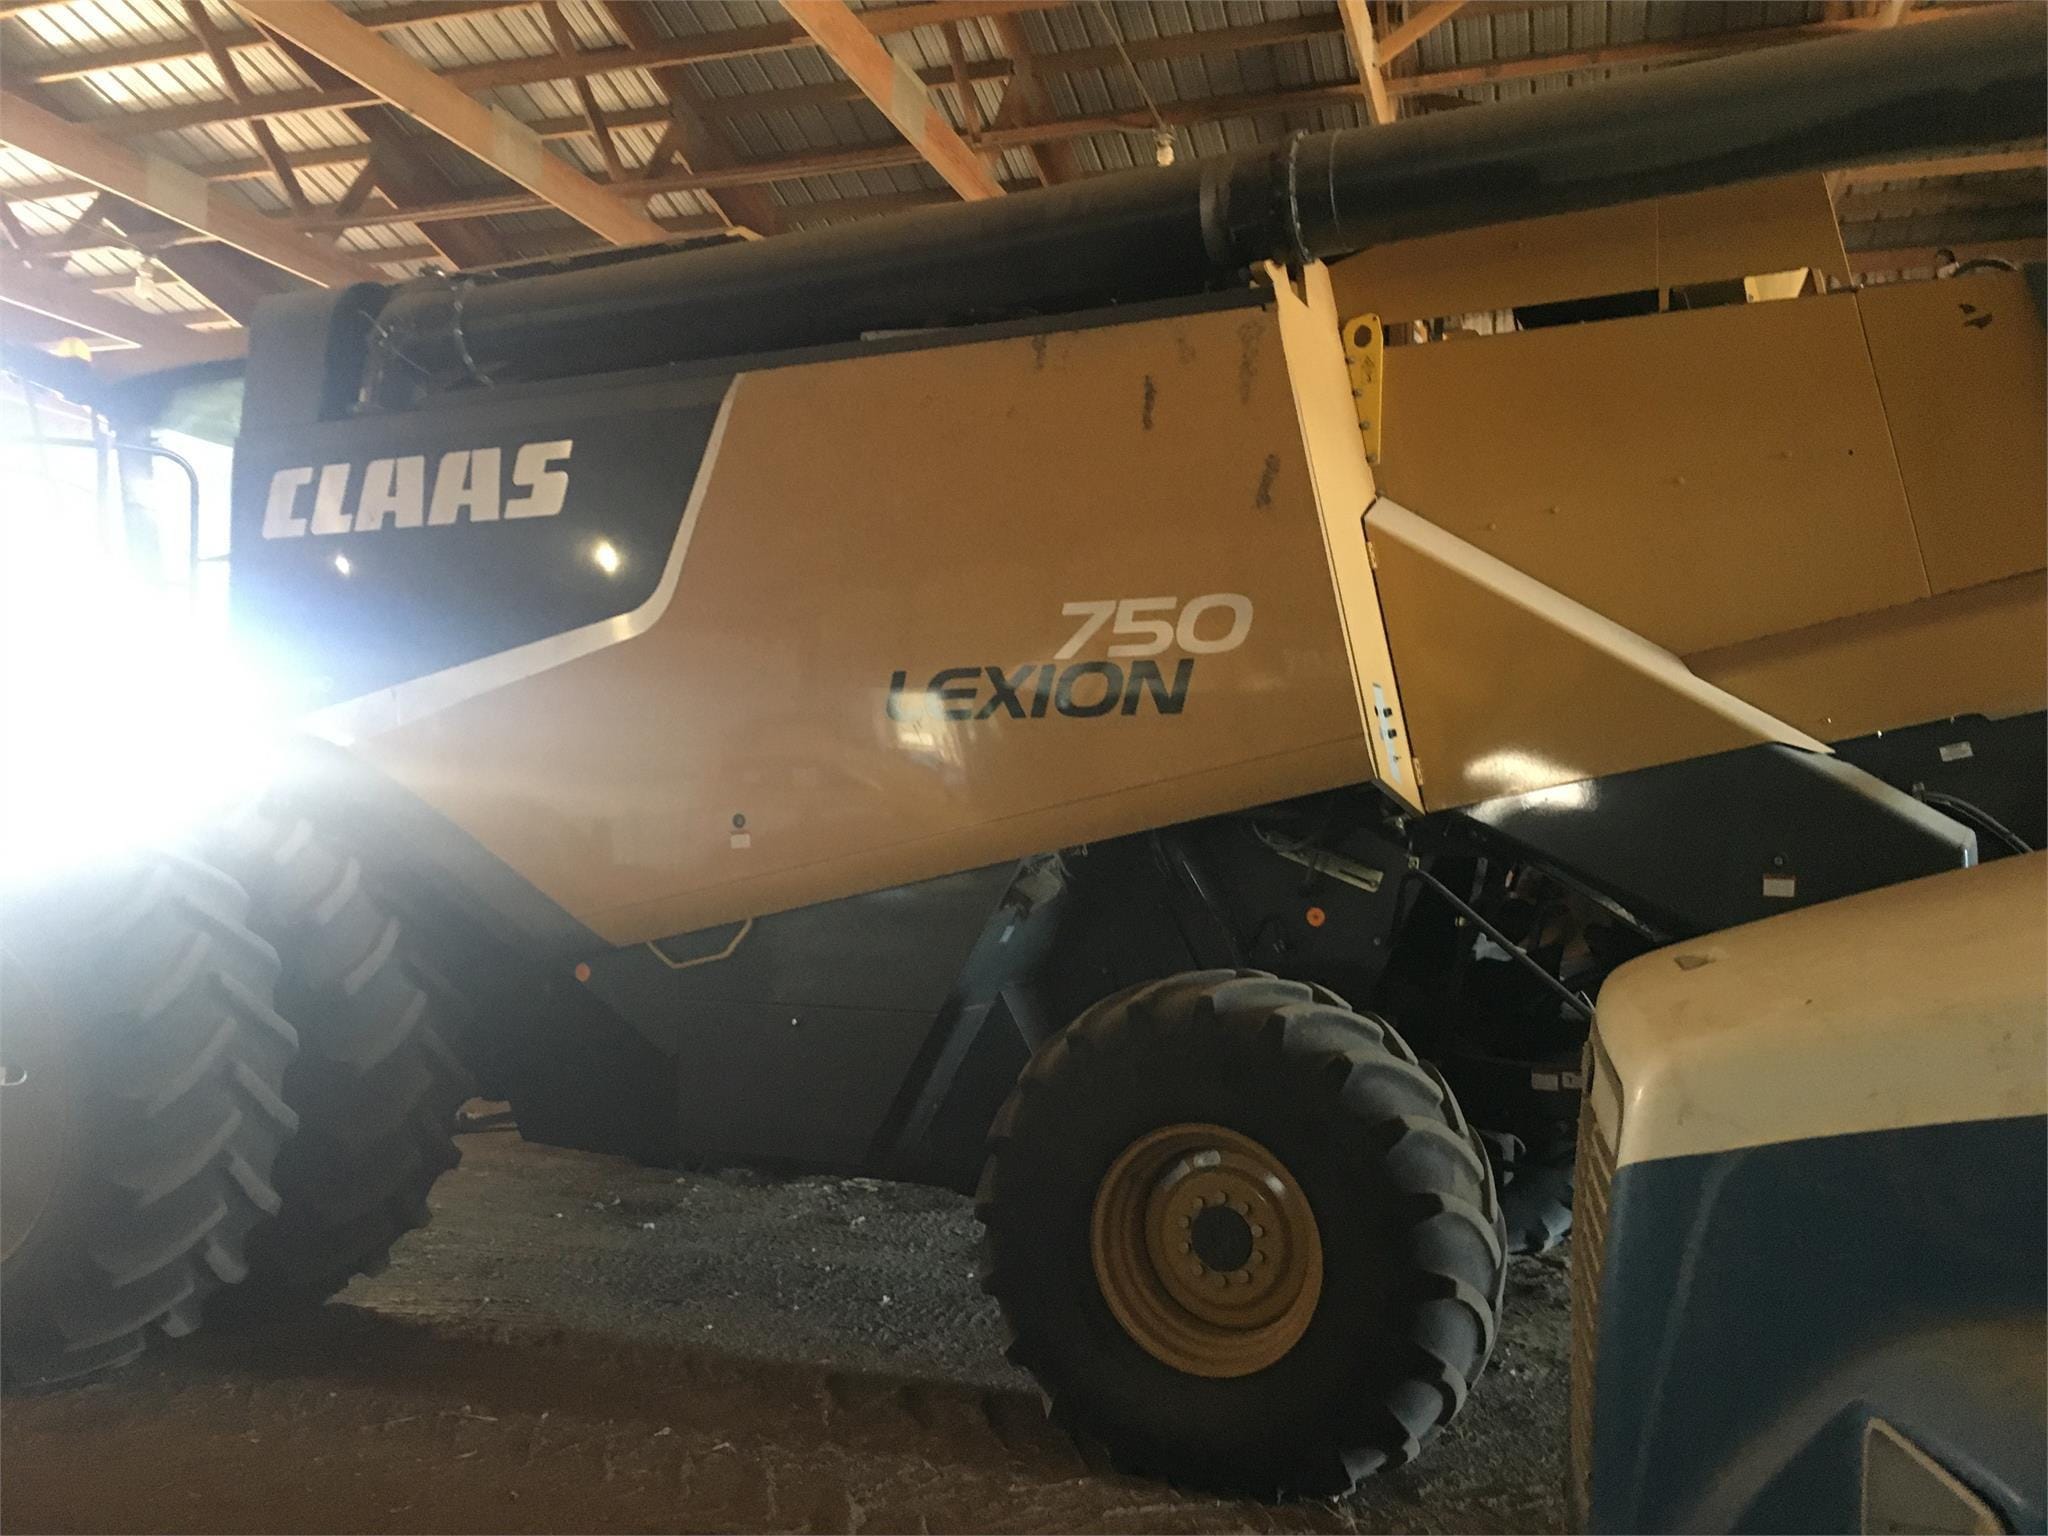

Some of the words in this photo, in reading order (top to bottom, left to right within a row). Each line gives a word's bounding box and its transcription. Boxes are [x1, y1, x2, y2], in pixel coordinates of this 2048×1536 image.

[262, 439, 573, 539] CLAAS
[1053, 593, 1253, 660] 750
[886, 658, 1194, 720] LEXION
